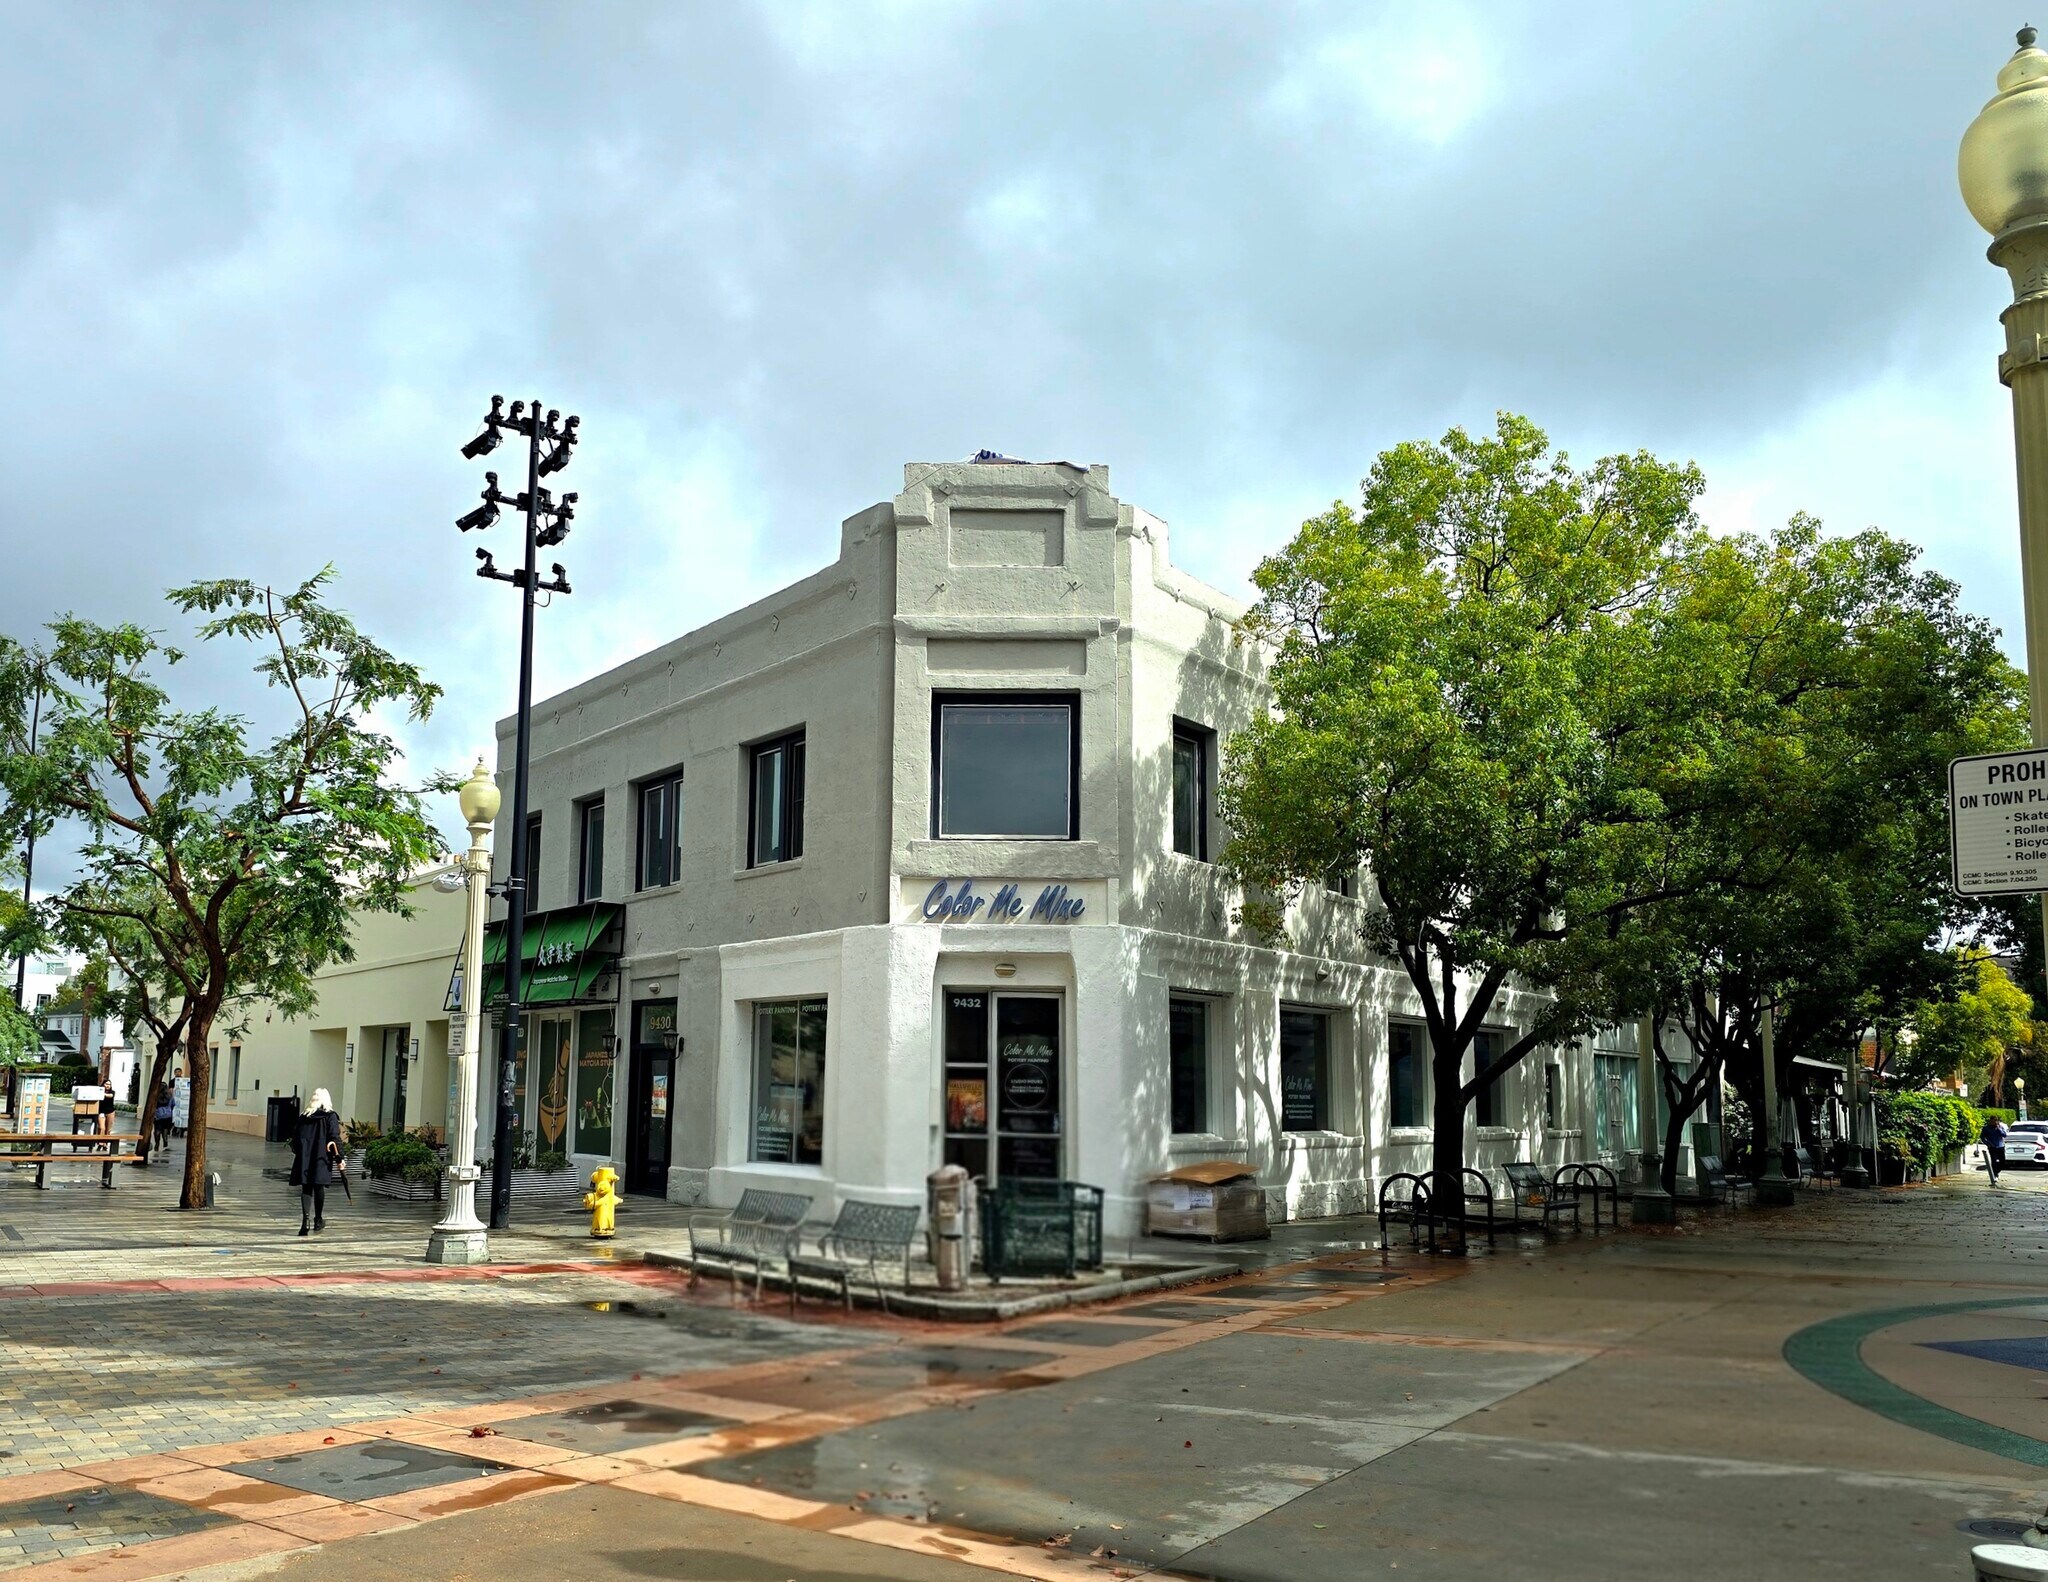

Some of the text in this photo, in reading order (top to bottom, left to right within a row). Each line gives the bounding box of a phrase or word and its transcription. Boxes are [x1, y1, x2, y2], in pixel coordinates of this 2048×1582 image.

[1988, 760, 2046, 785] PROH
[1960, 795, 1978, 809] ON
[1983, 790, 2023, 807] TOWN
[2009, 868, 2038, 876] 9.10.305
[922, 879, 1086, 923] Color Me Mine
[801, 1004, 821, 1012] POTTERY
[953, 998, 981, 1008] 9432
[650, 1016, 671, 1030] 9430
[1003, 1043, 1054, 1057] Color Me Mine
